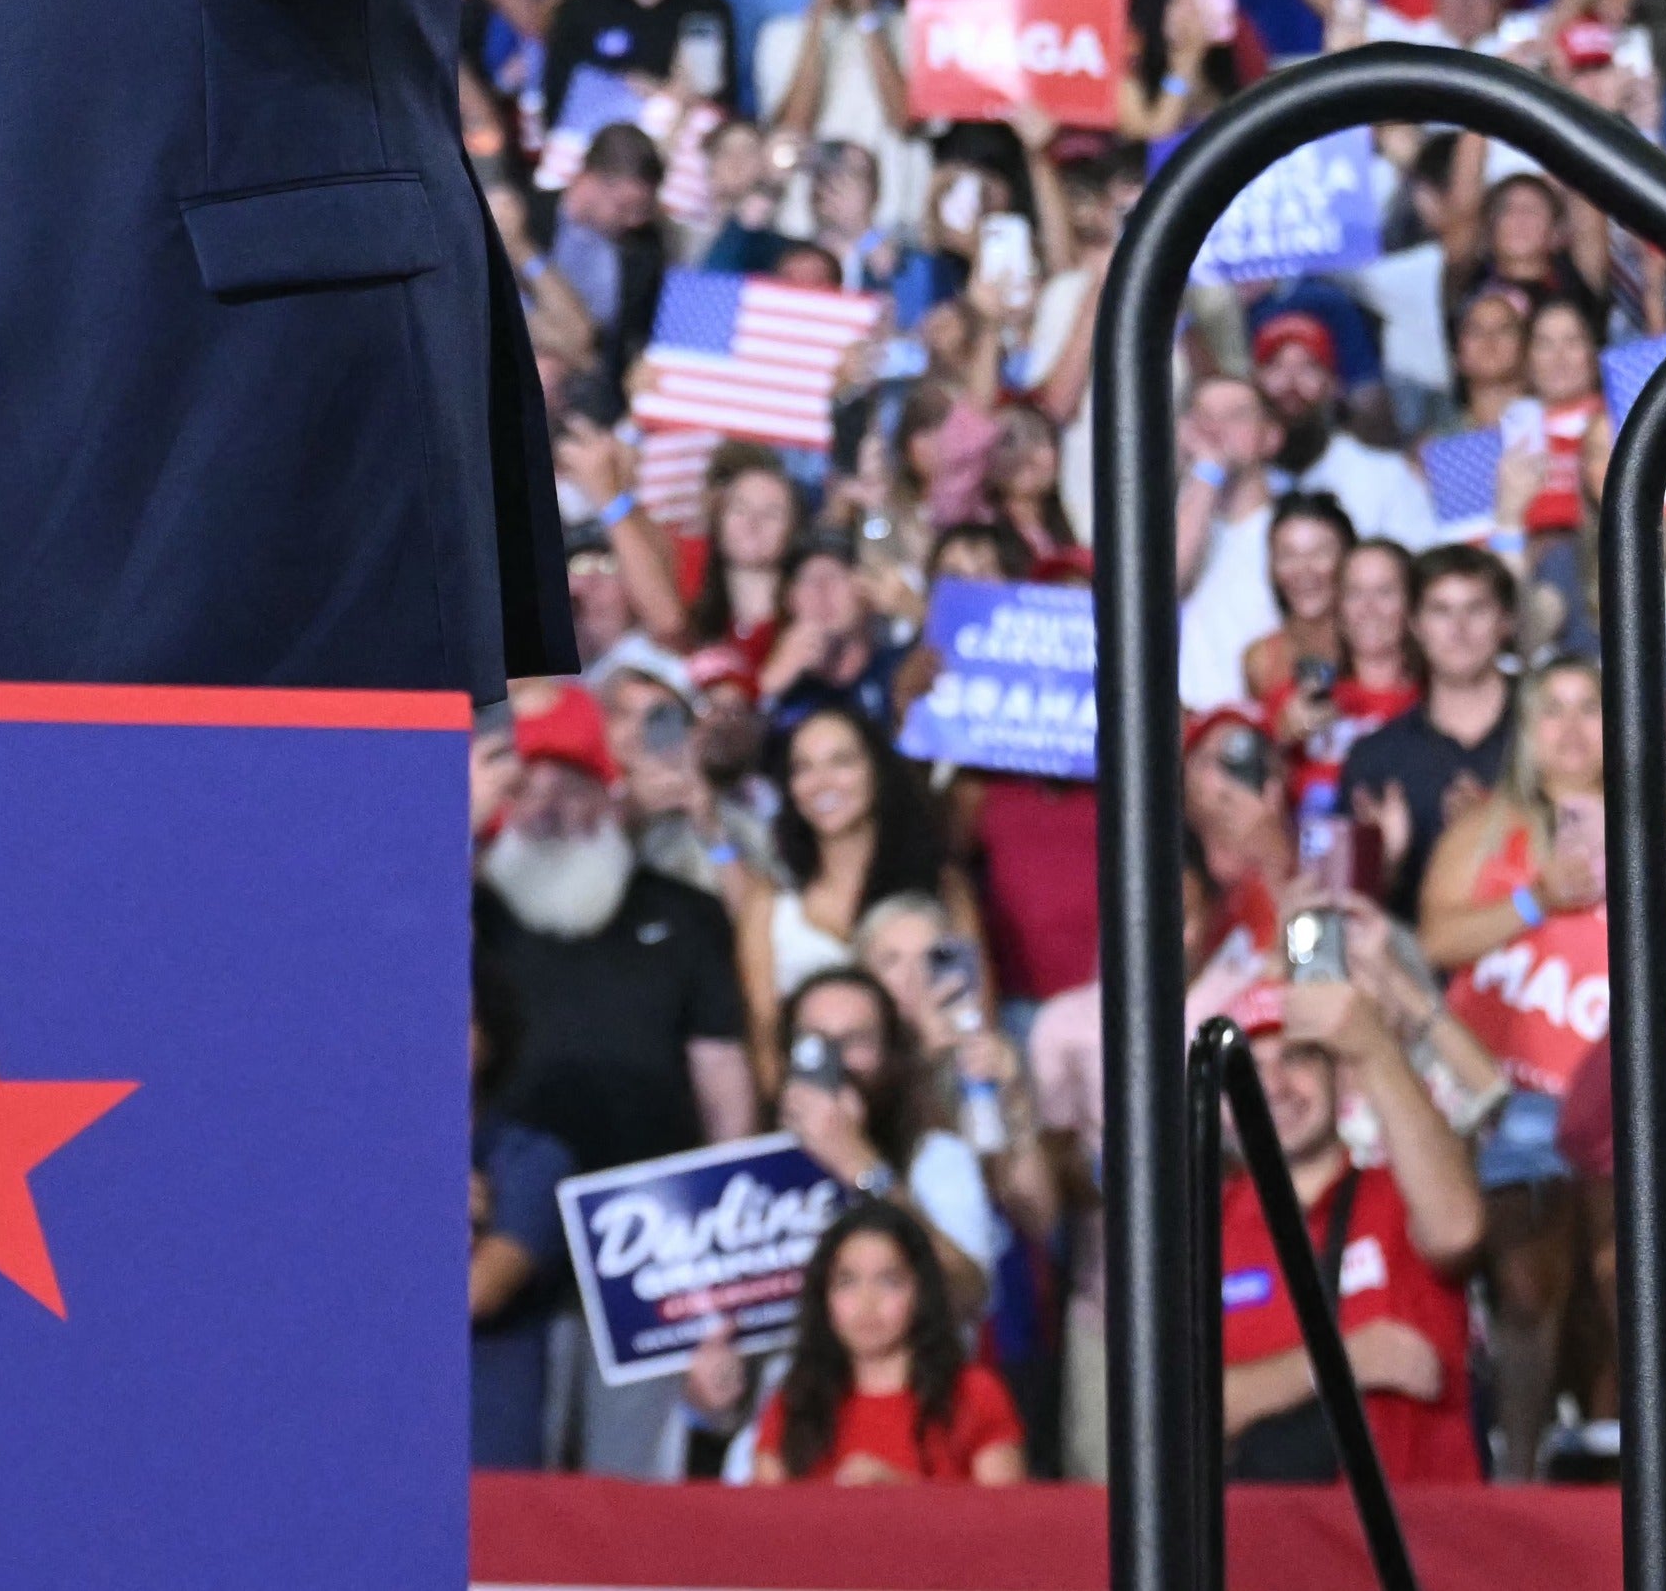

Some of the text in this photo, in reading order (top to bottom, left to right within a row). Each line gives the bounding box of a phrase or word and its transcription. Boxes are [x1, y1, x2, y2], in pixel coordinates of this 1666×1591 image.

[927, 18, 1109, 80] MAGA
[1473, 942, 1610, 1043] MAG
[589, 1171, 841, 1279] Darline
